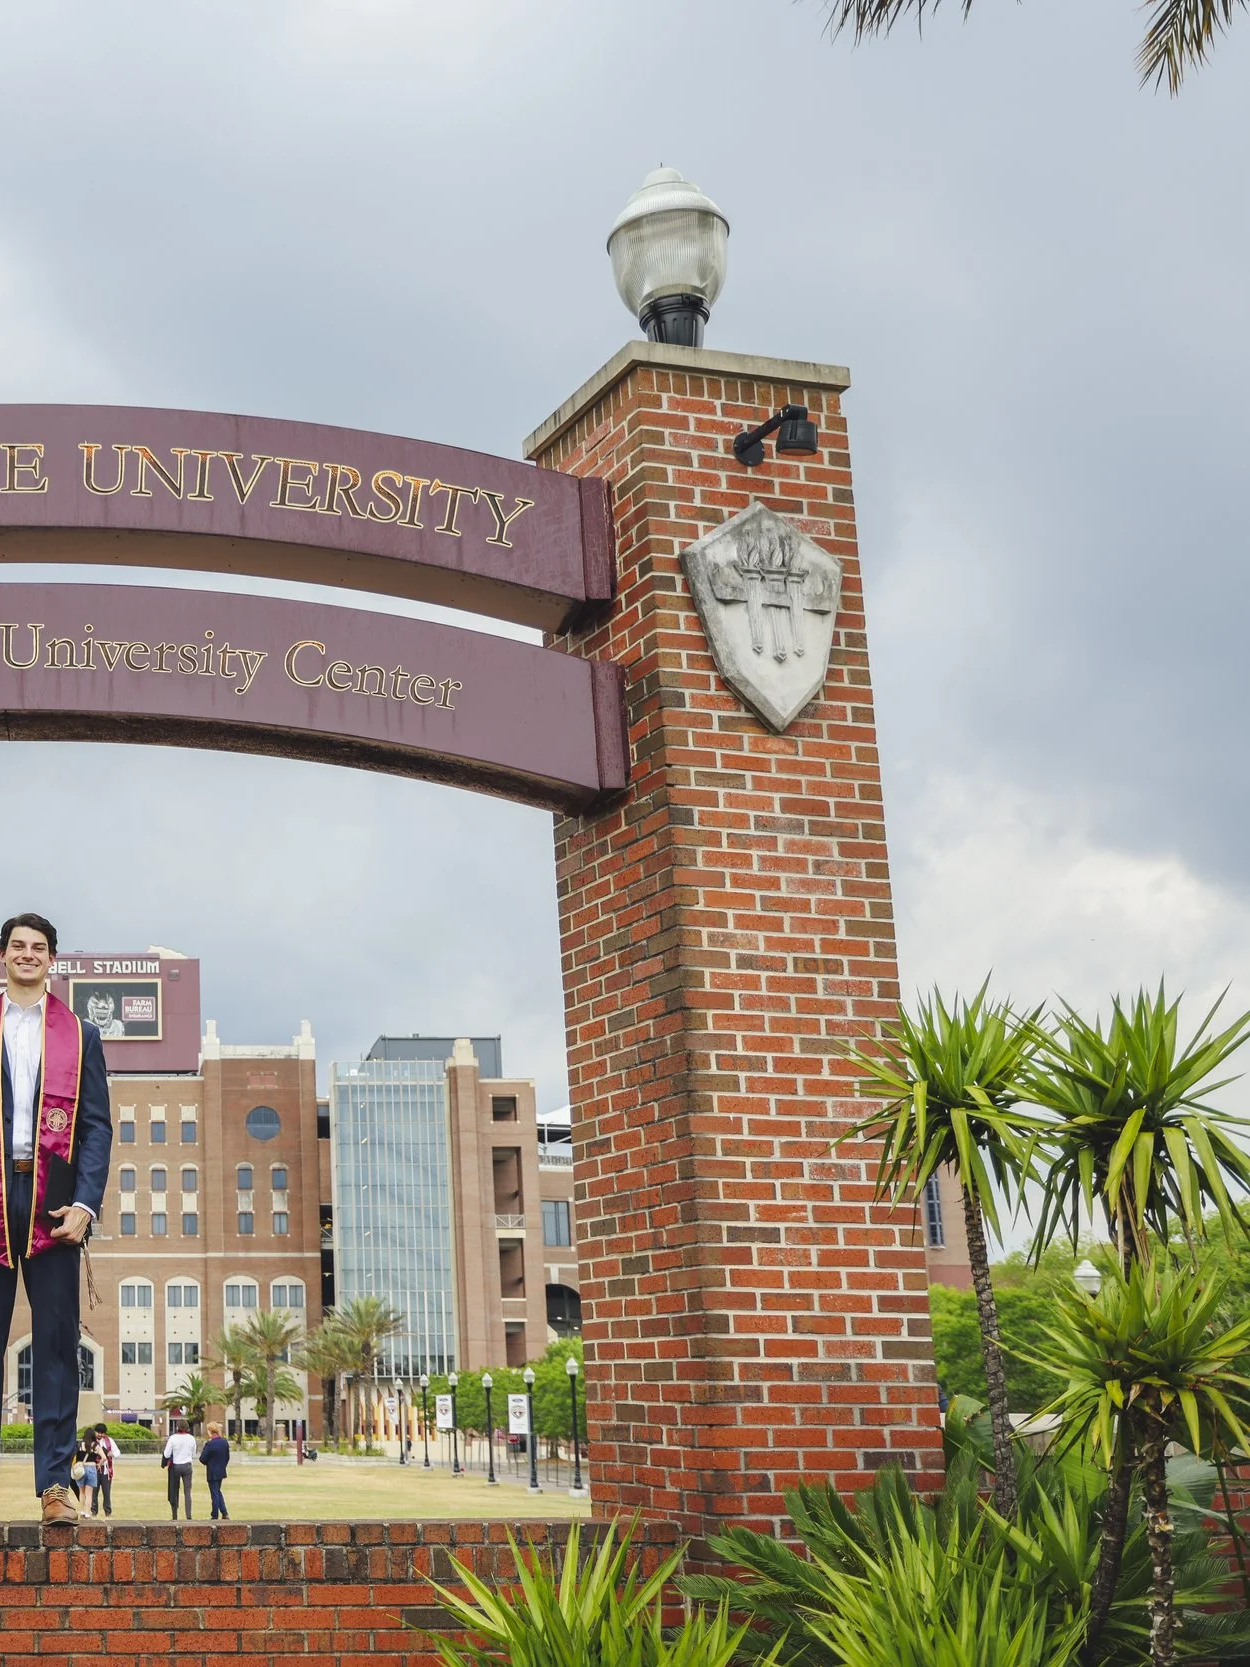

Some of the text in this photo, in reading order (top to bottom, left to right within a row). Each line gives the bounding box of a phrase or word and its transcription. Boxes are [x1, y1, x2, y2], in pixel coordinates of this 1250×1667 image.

[78, 441, 535, 548] UNIVERSITY
[284, 639, 463, 711] Center
[48, 961, 86, 974] BELL
[93, 961, 160, 974] STADIUM
